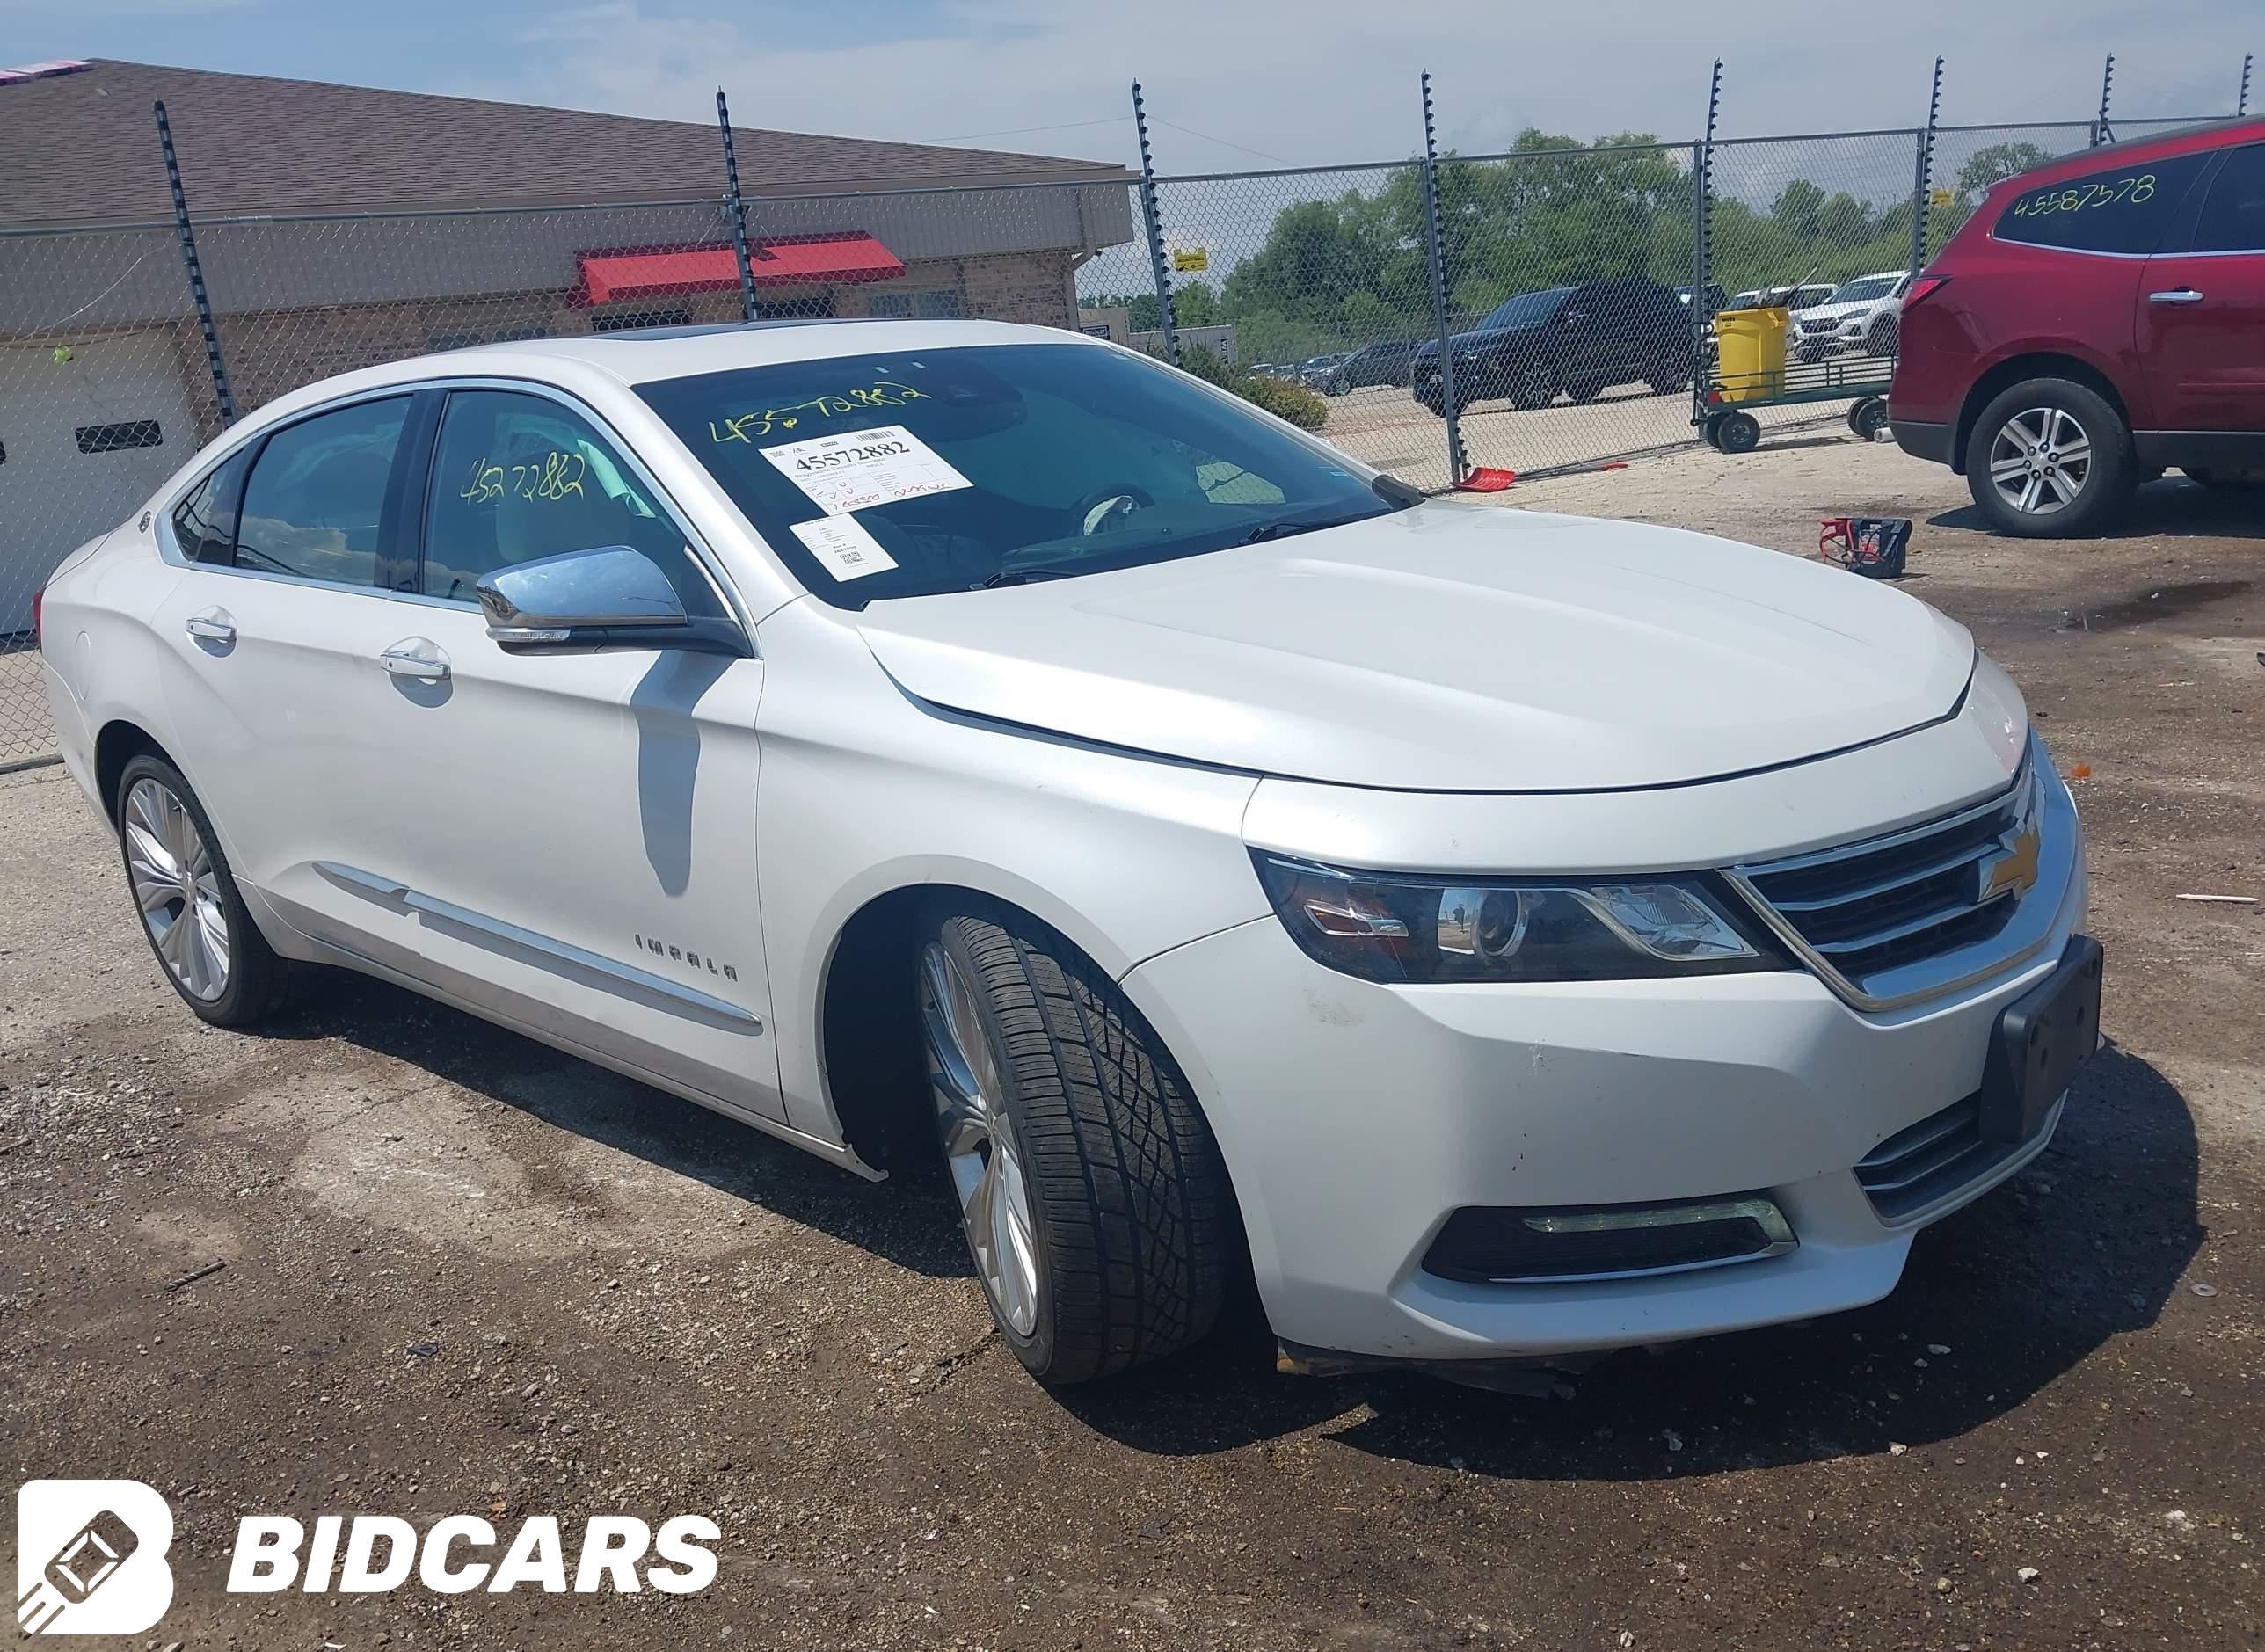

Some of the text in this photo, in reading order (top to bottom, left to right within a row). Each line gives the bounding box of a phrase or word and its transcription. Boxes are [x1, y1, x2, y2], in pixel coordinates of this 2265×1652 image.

[2014, 175, 2156, 217] 45587578
[797, 441, 910, 470] 45572882
[635, 934, 738, 982] IMPALA
